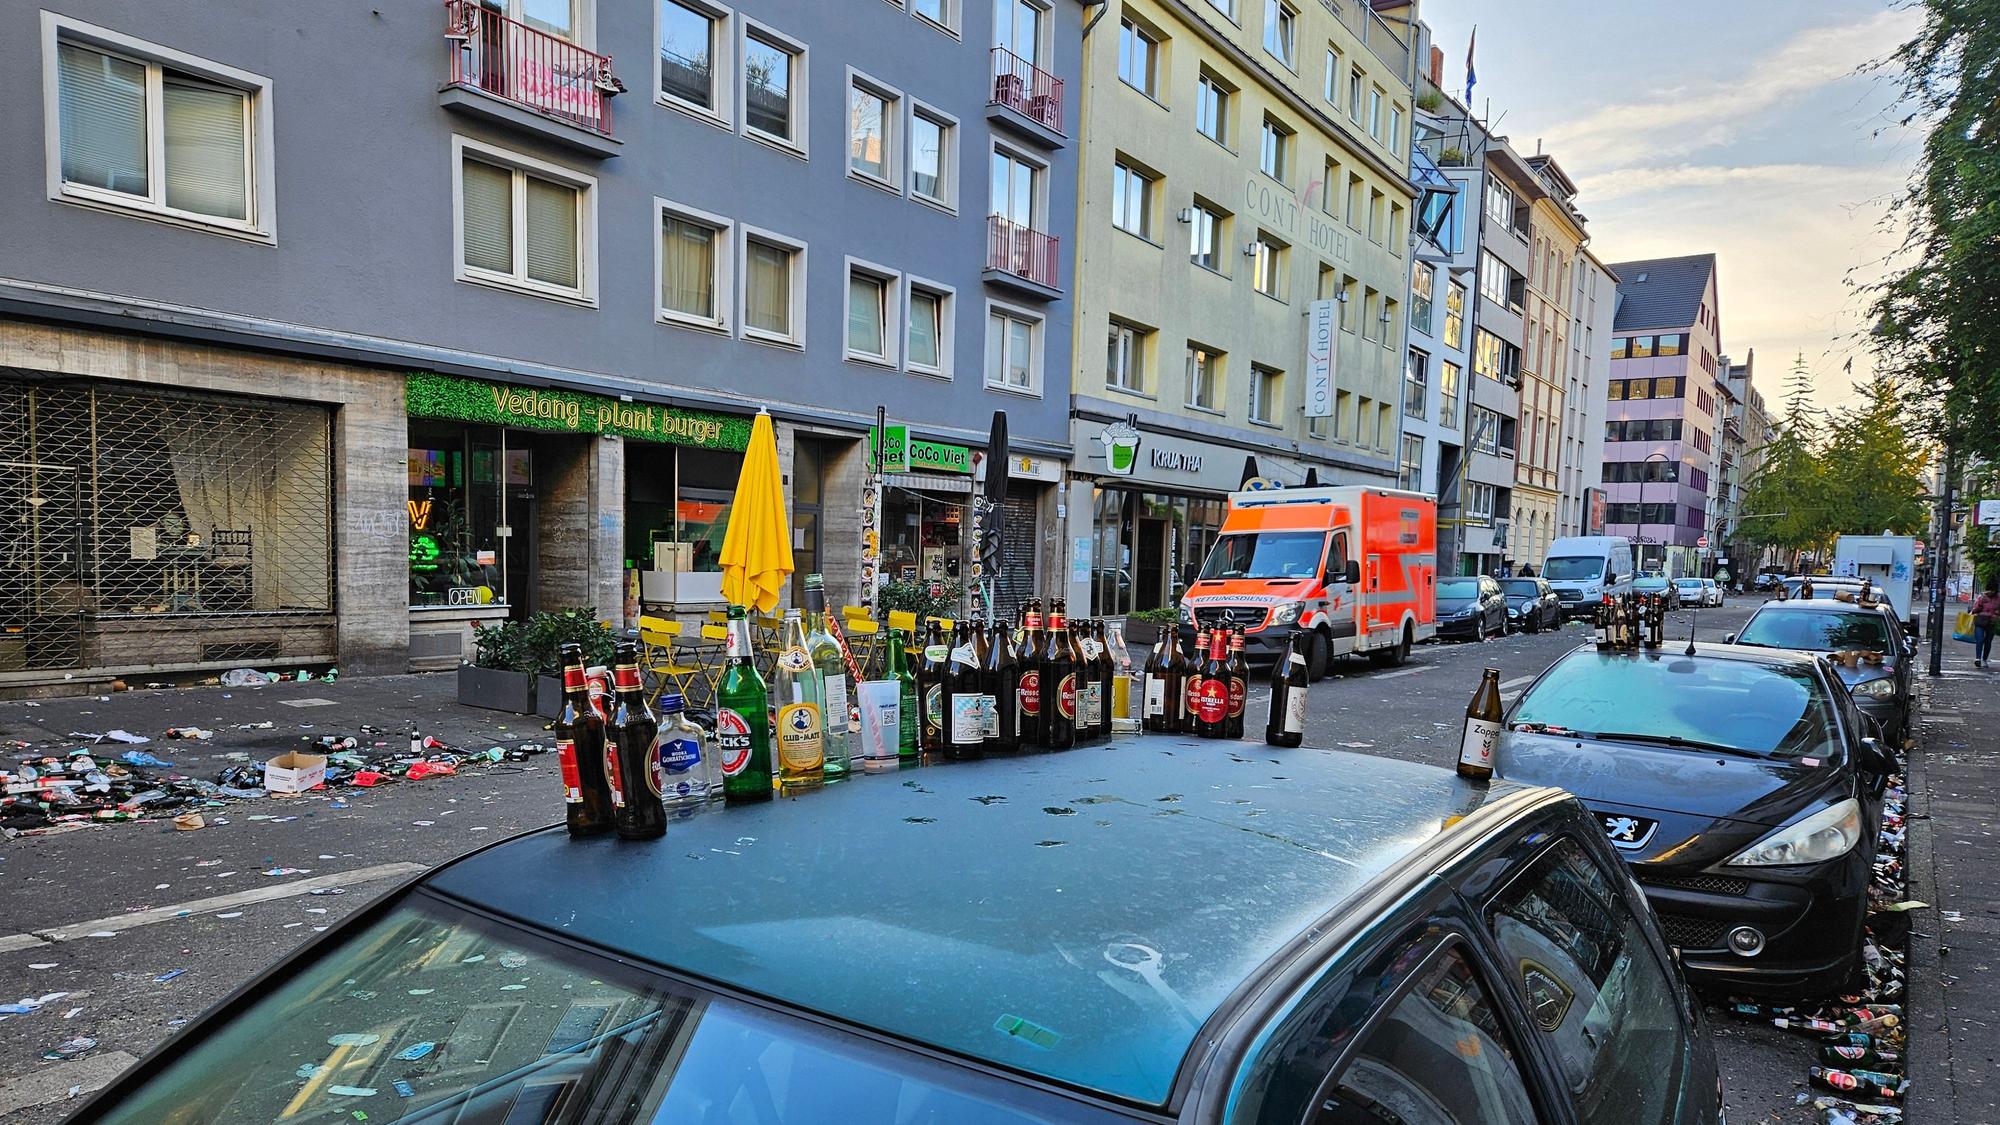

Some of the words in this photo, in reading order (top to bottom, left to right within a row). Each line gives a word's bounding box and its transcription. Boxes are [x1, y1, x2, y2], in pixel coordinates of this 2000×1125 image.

[1309, 216, 1350, 263] HOTEL
[1317, 301, 1331, 351] HOTEL
[492, 386, 579, 428] Vedang
[598, 401, 655, 431] plant
[663, 408, 723, 443] burger
[909, 444, 940, 462] CoCo
[943, 449, 965, 465] Viet
[1152, 448, 1182, 469] KRUA
[450, 589, 480, 605] OPEN
[1195, 595, 1274, 603] RETTUNGSDIENST
[1201, 697, 1224, 705] ESTRELLA
[720, 735, 751, 748] ECK'S
[783, 732, 820, 742] CLUB-MATE
